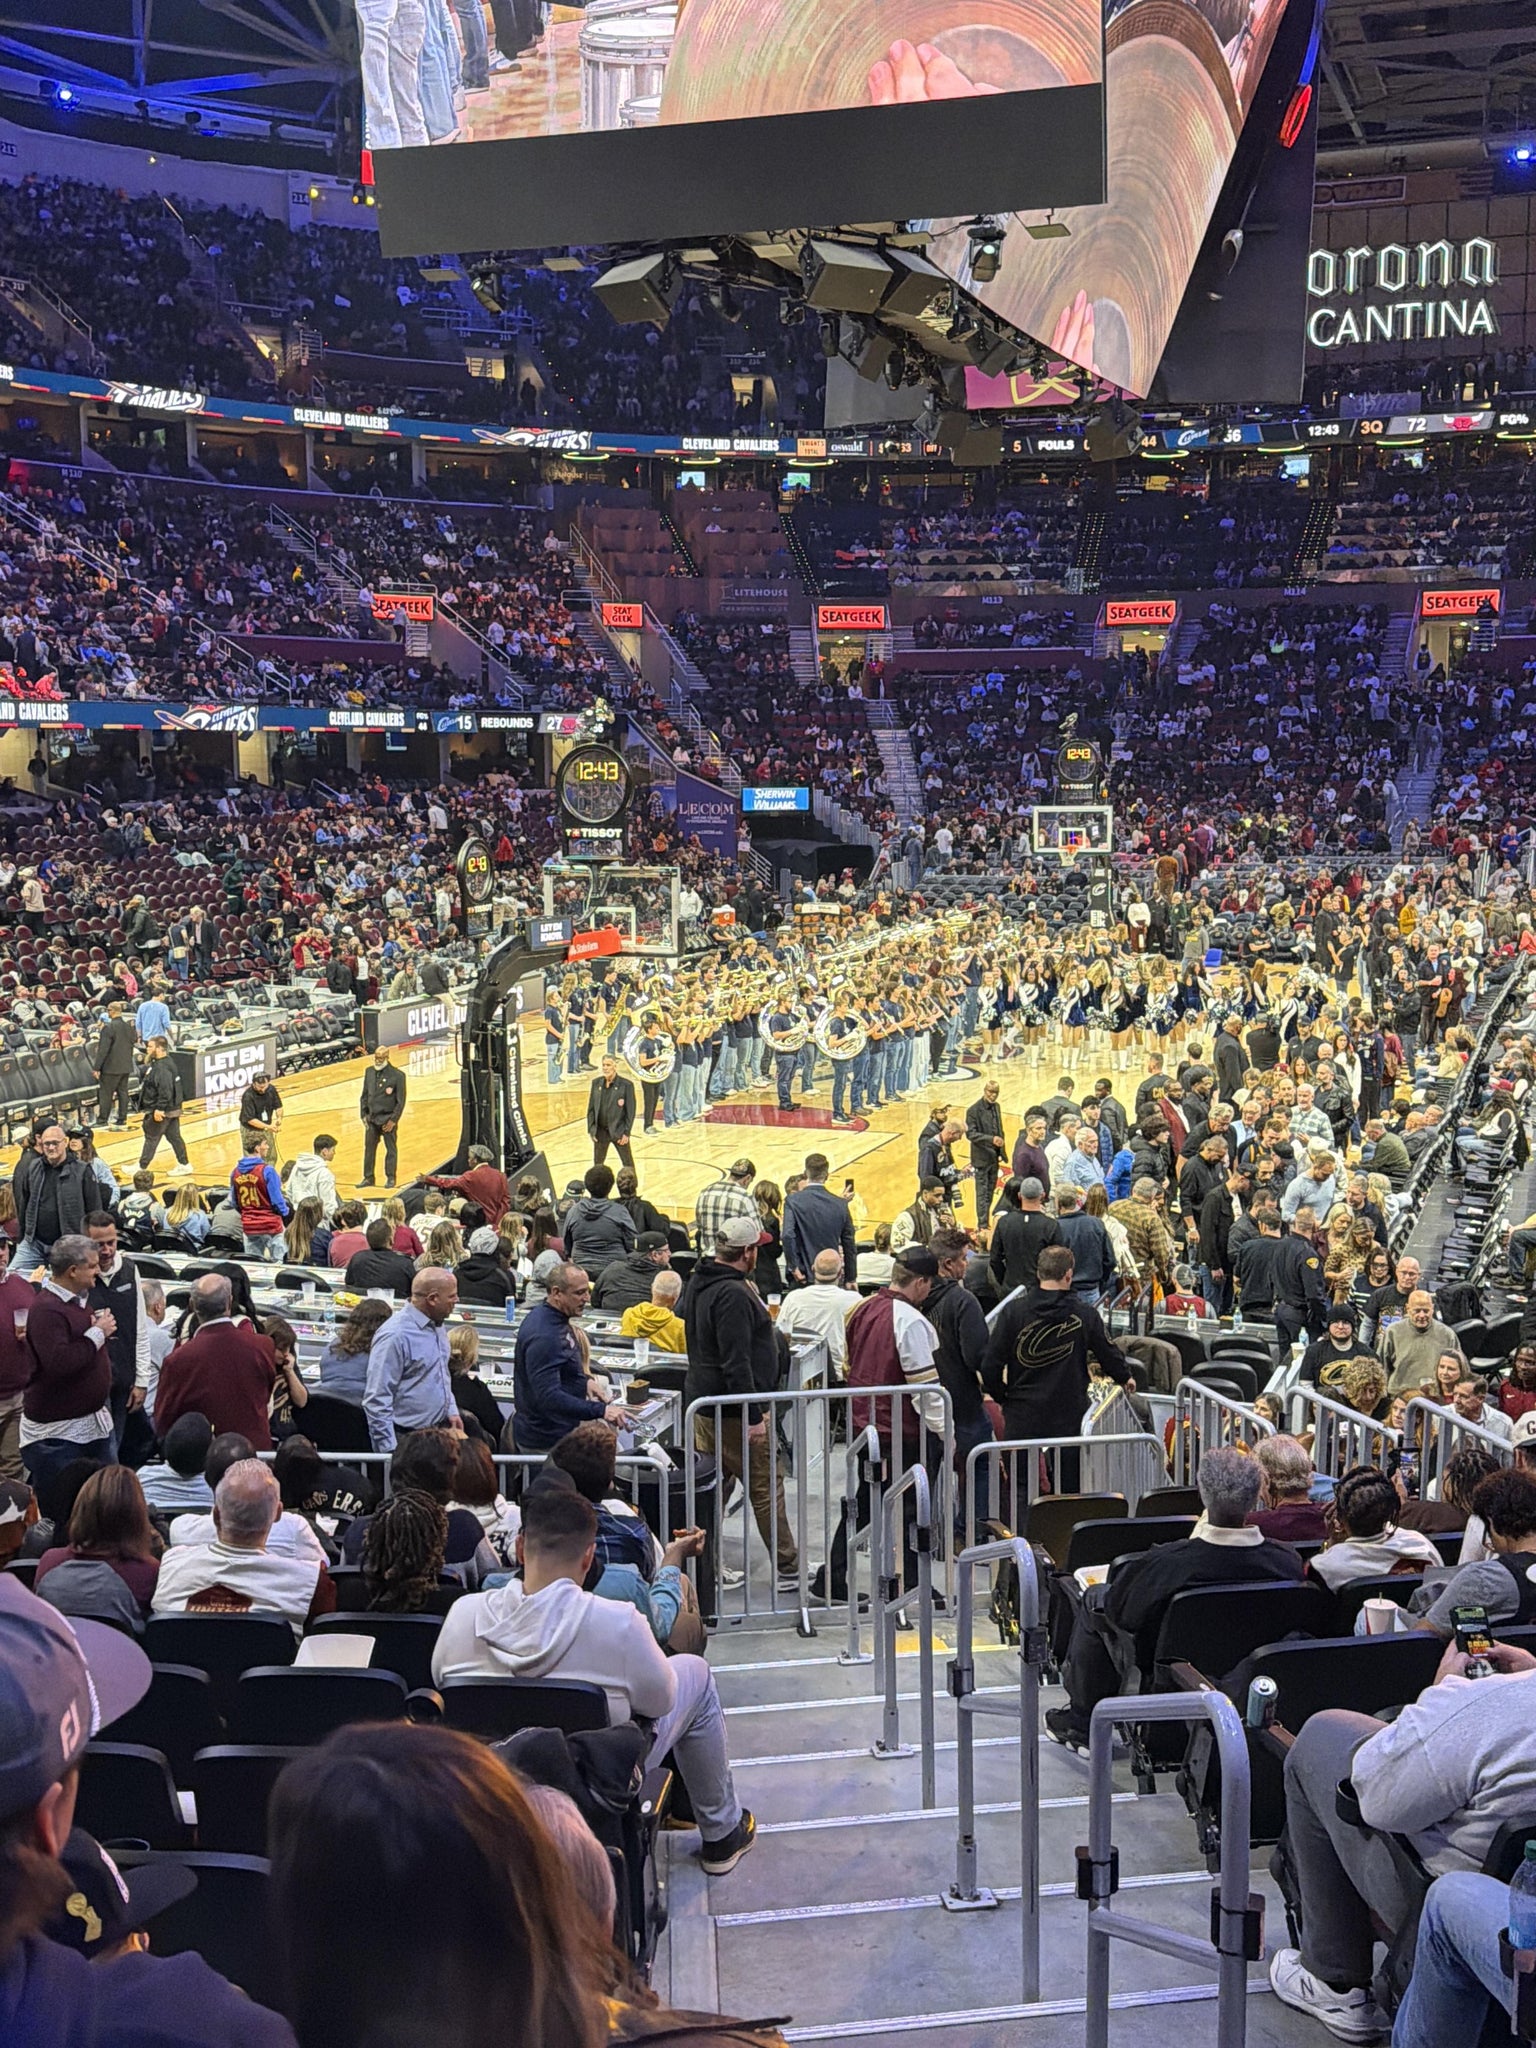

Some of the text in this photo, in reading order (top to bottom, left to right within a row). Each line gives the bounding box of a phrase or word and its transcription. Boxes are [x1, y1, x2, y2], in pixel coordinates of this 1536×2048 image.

[1307, 298, 1495, 347] CANTINA
[293, 407, 389, 430] CLEVELAND CAVALIERS
[1406, 417, 1428, 432] 72
[1500, 413, 1529, 426] FG%
[1308, 424, 1340, 437] 12:43
[1360, 421, 1384, 434] 3Q
[682, 437, 780, 451] CLEVELAND CAVALIERS
[831, 441, 863, 453] oswald
[1037, 439, 1075, 451] FOULS
[1141, 435, 1158, 447] 44
[734, 588, 788, 597] LITEHOUSE
[375, 599, 431, 615] SEATEEK
[613, 606, 632, 614] SEAT
[1109, 604, 1173, 619] SEATGEEK
[612, 615, 633, 623] GEEK
[821, 610, 881, 624] SEATGEEK
[18, 702, 69, 721] CAVALIERS
[328, 711, 405, 727] CLEVELAND CAVALIERS
[459, 715, 473, 730] 15
[481, 717, 534, 729] REBOUNDS
[546, 714, 562, 731] 27
[1066, 747, 1091, 760] 12:43
[579, 761, 619, 781] 12:43
[753, 788, 797, 800] SHERWIN
[580, 828, 623, 838] TISSOT
[204, 1043, 265, 1073] LET EM
[508, 1046, 528, 1146] Cleveland Clinic
[239, 1186, 261, 1208] 24
